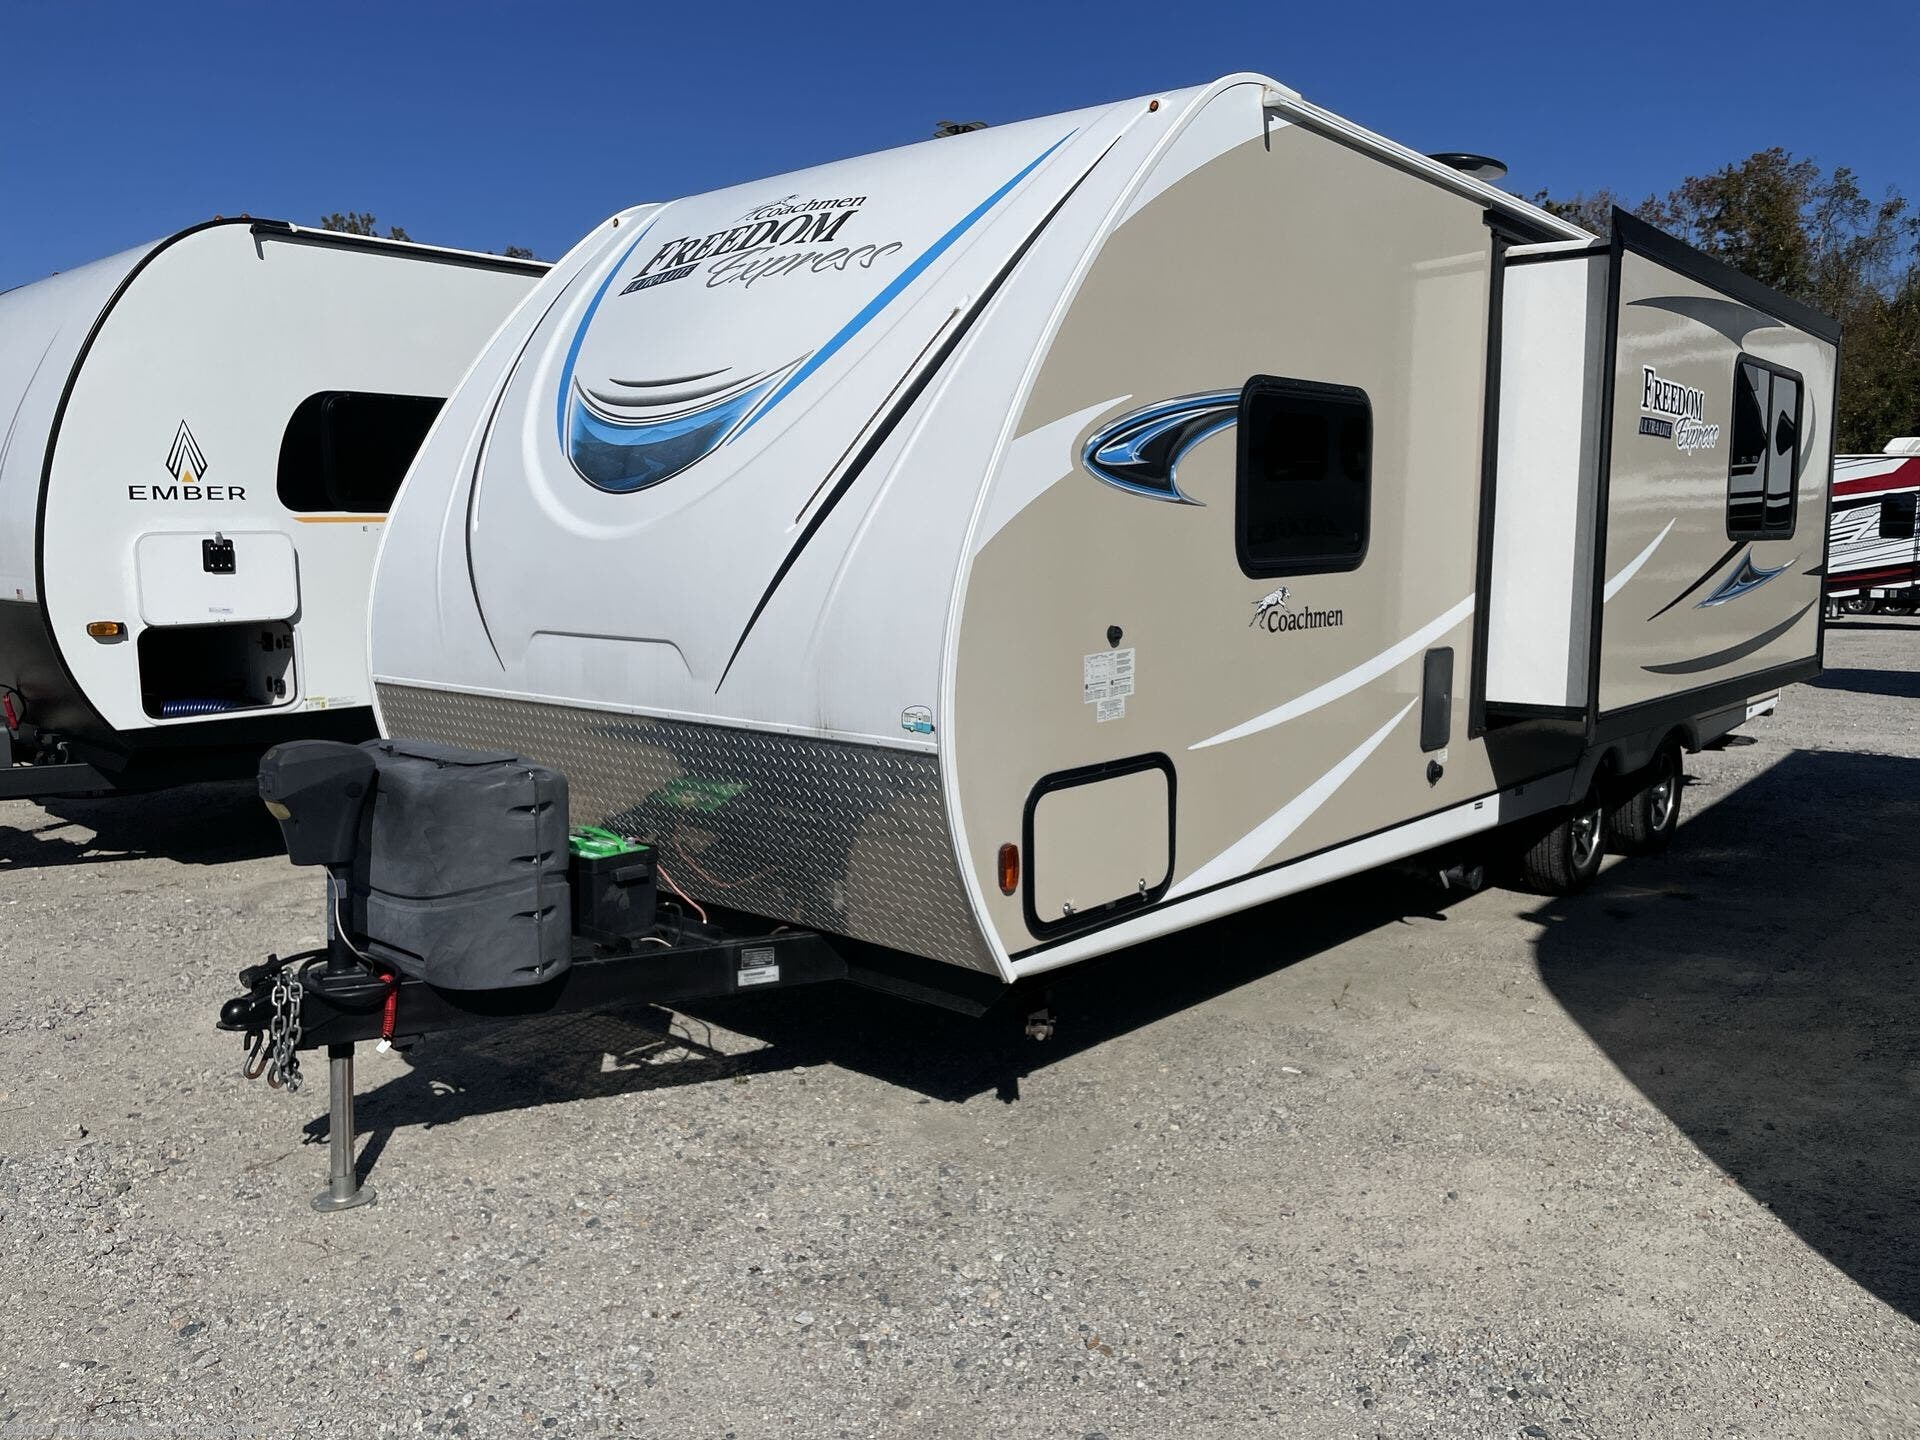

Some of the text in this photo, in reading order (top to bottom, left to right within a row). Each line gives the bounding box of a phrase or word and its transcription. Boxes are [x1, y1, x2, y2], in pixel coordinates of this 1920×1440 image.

[755, 196, 867, 221] Coachmen
[636, 210, 859, 277] FREEDOM
[706, 241, 903, 289] Express
[1642, 368, 1704, 420] FREEDOM
[1675, 416, 1718, 453] Express
[128, 485, 247, 501] EMBER
[1267, 606, 1343, 633] Coachmen
